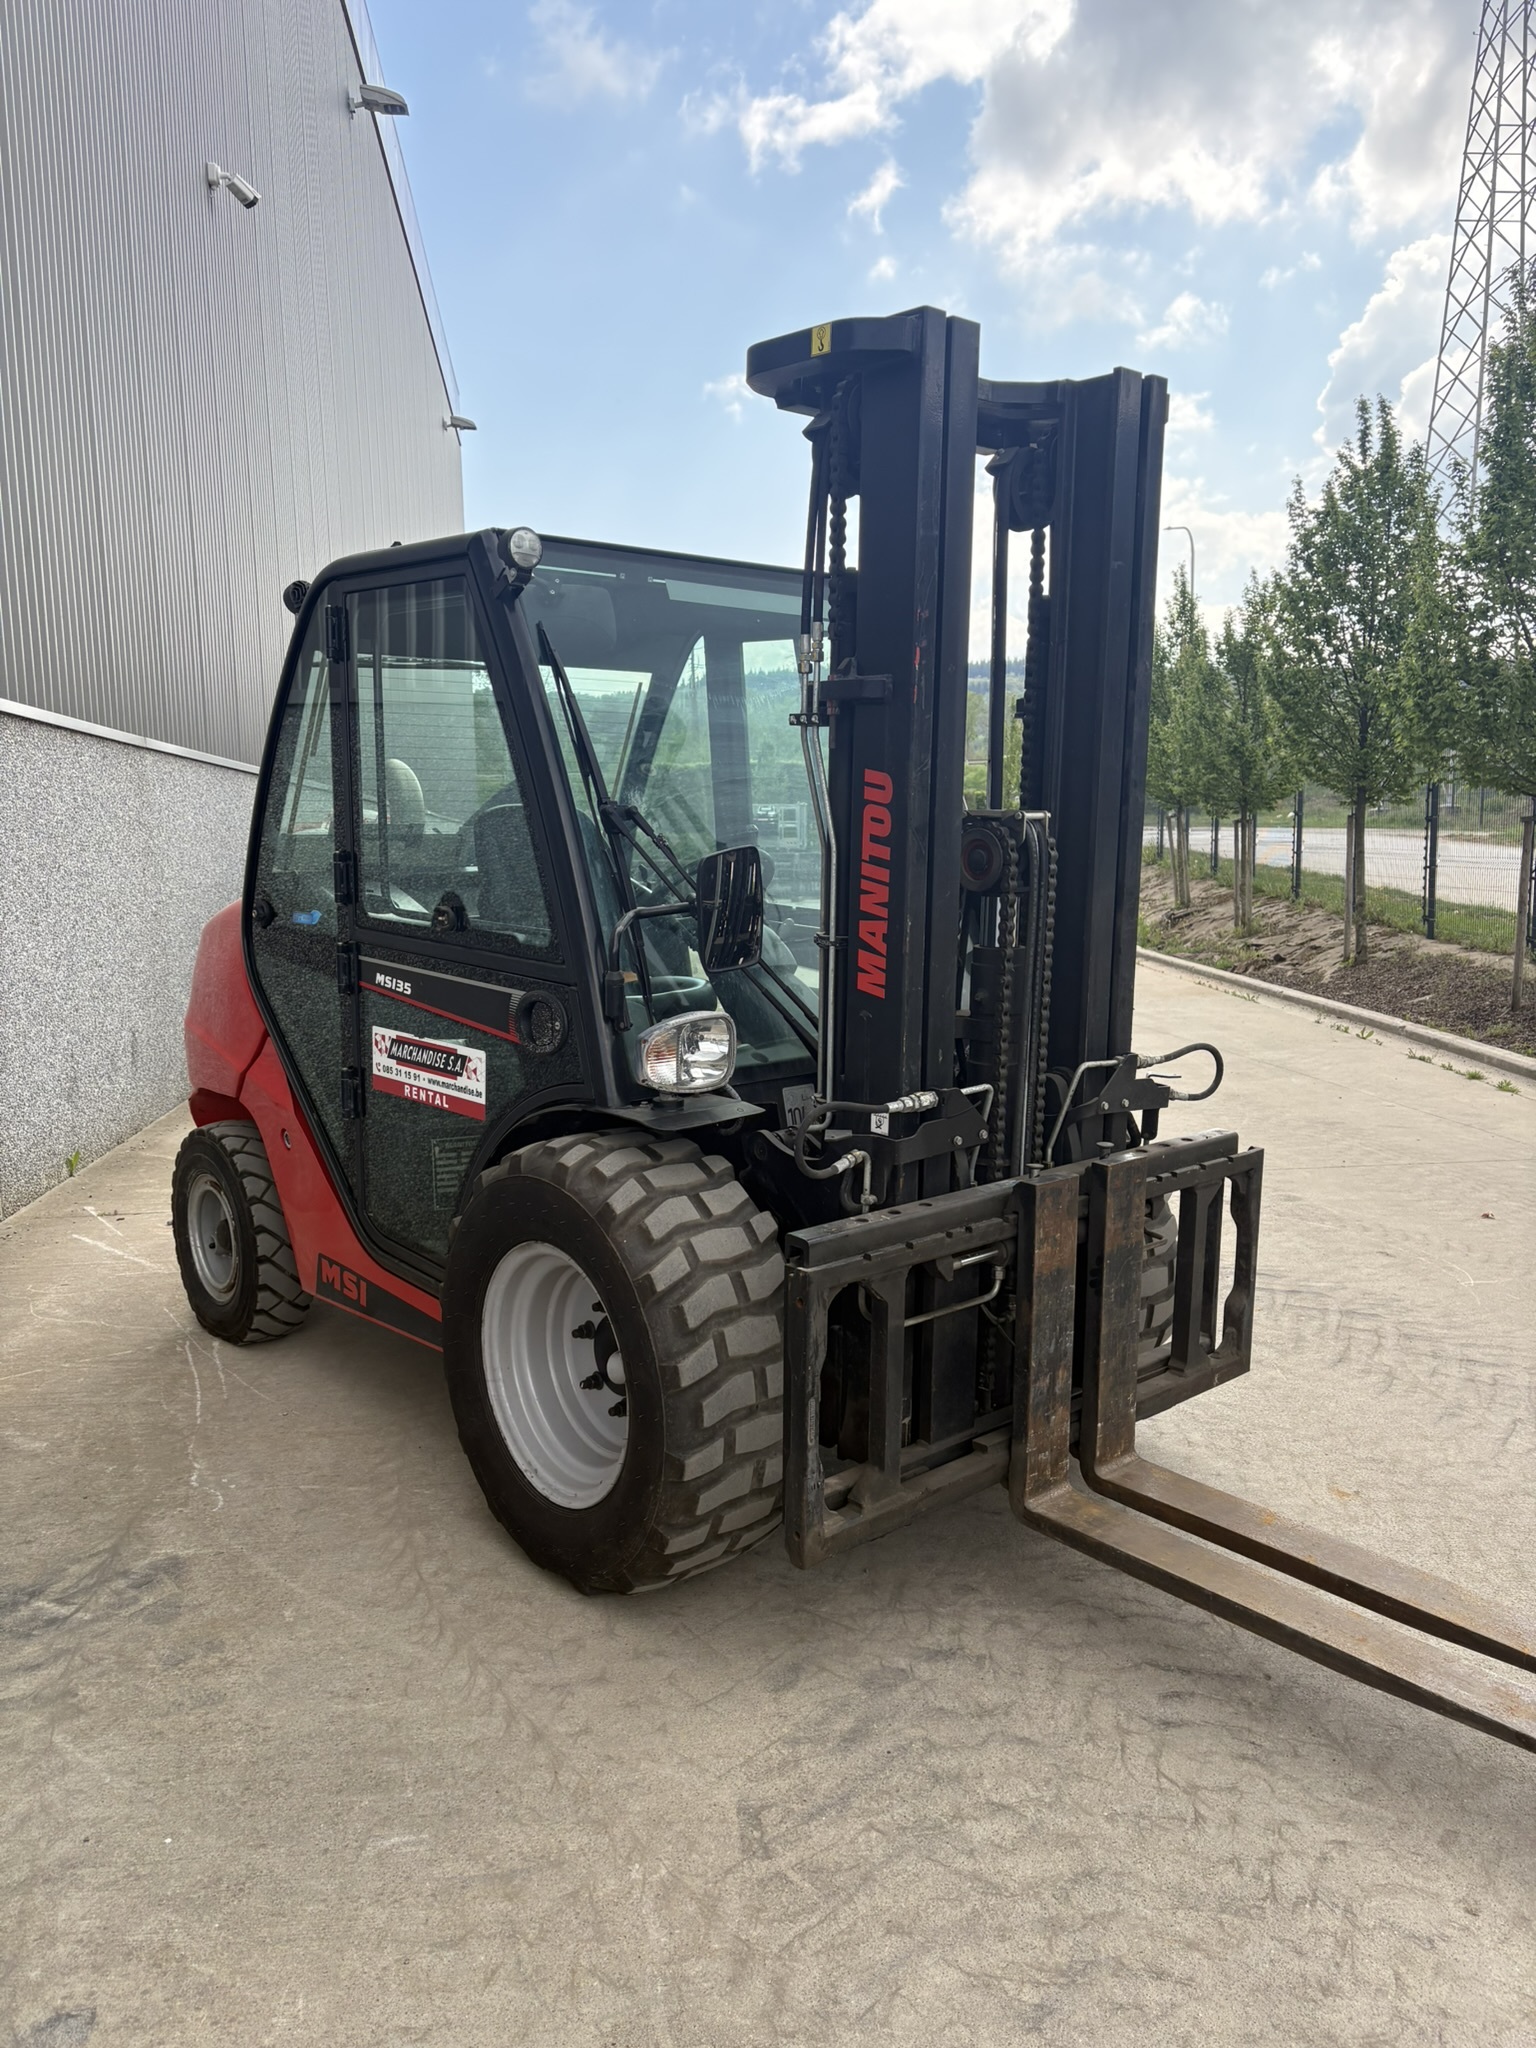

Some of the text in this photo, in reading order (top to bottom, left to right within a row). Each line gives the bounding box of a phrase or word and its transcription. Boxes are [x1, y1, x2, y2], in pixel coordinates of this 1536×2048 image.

[857, 769, 893, 998] MANITOU
[390, 1042, 463, 1074] MARCHANDISE S.A.
[382, 1064, 483, 1099] 085 31 15 91 www.marchandise.be
[404, 1084, 449, 1109] RENTAL
[322, 1259, 367, 1307] MSI
